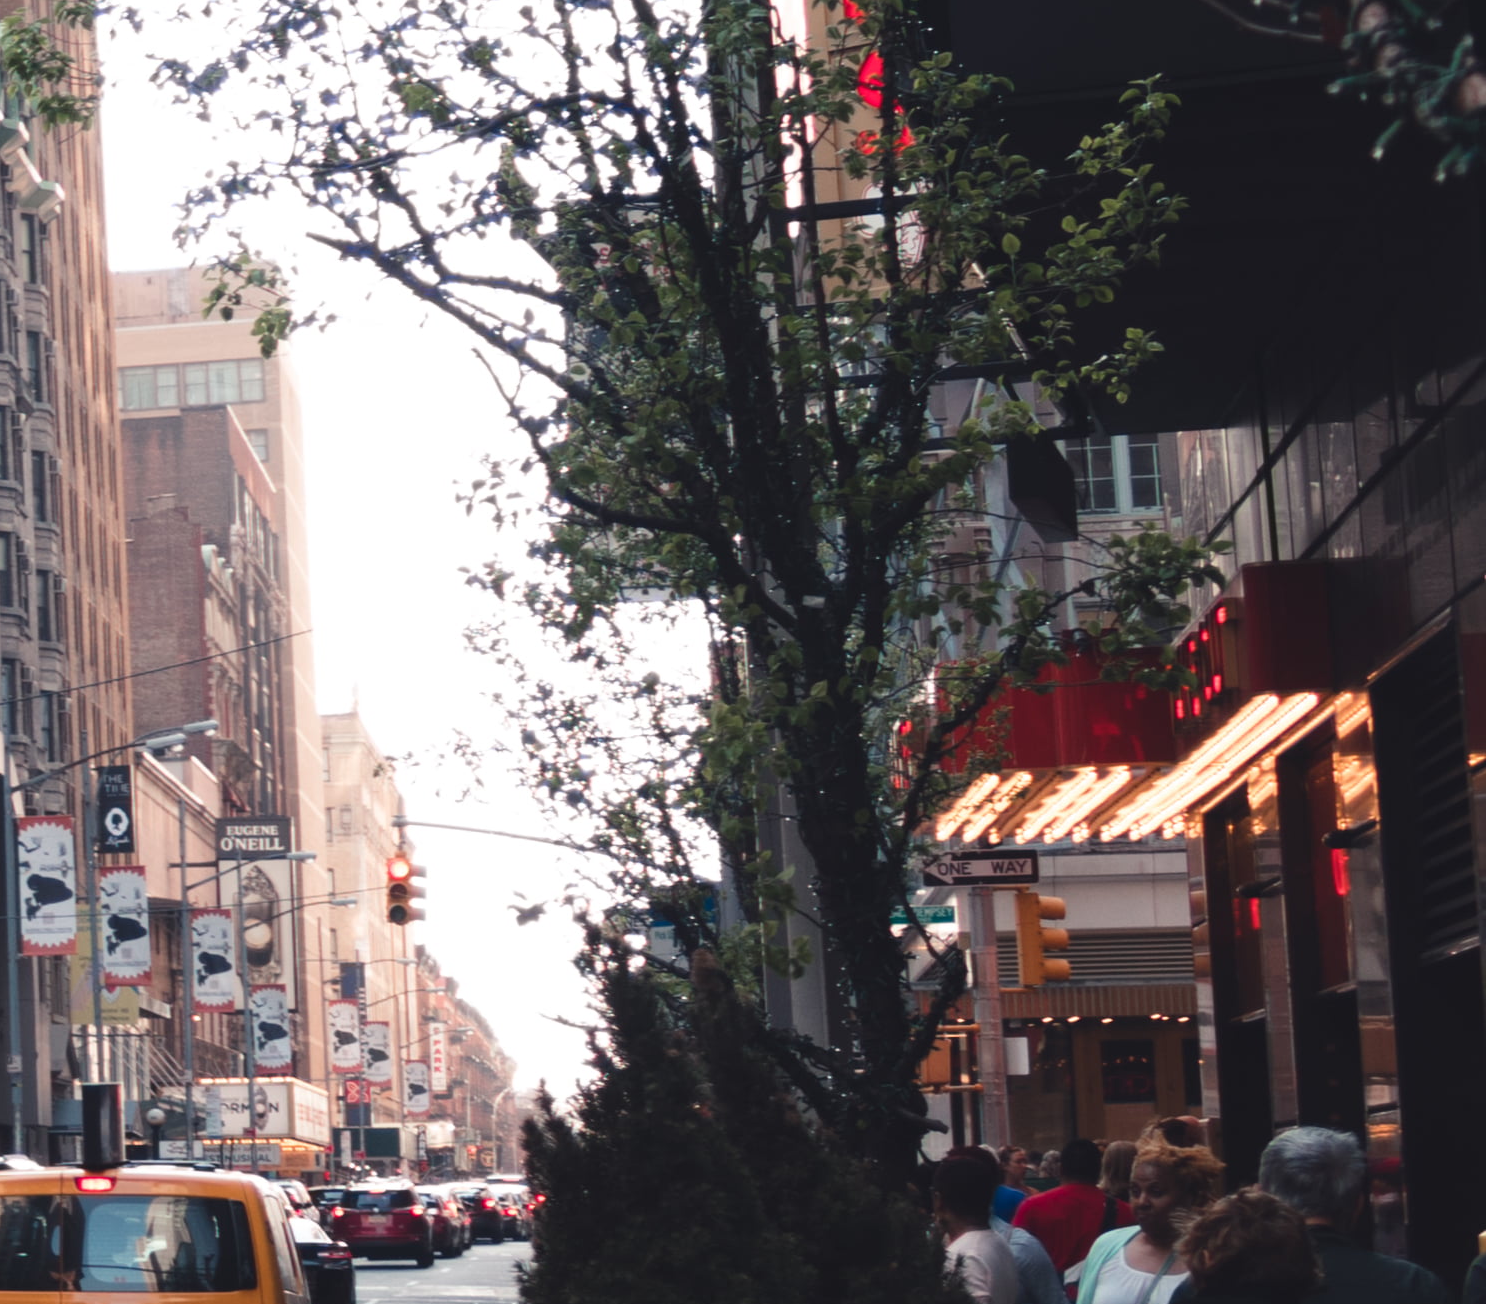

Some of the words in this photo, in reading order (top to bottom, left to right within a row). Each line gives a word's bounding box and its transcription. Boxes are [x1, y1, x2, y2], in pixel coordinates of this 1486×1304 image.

[226, 825, 279, 837] EUGENE
[220, 836, 285, 853] O'NEILL
[936, 861, 972, 876] ONE
[990, 859, 1028, 874] WAY
